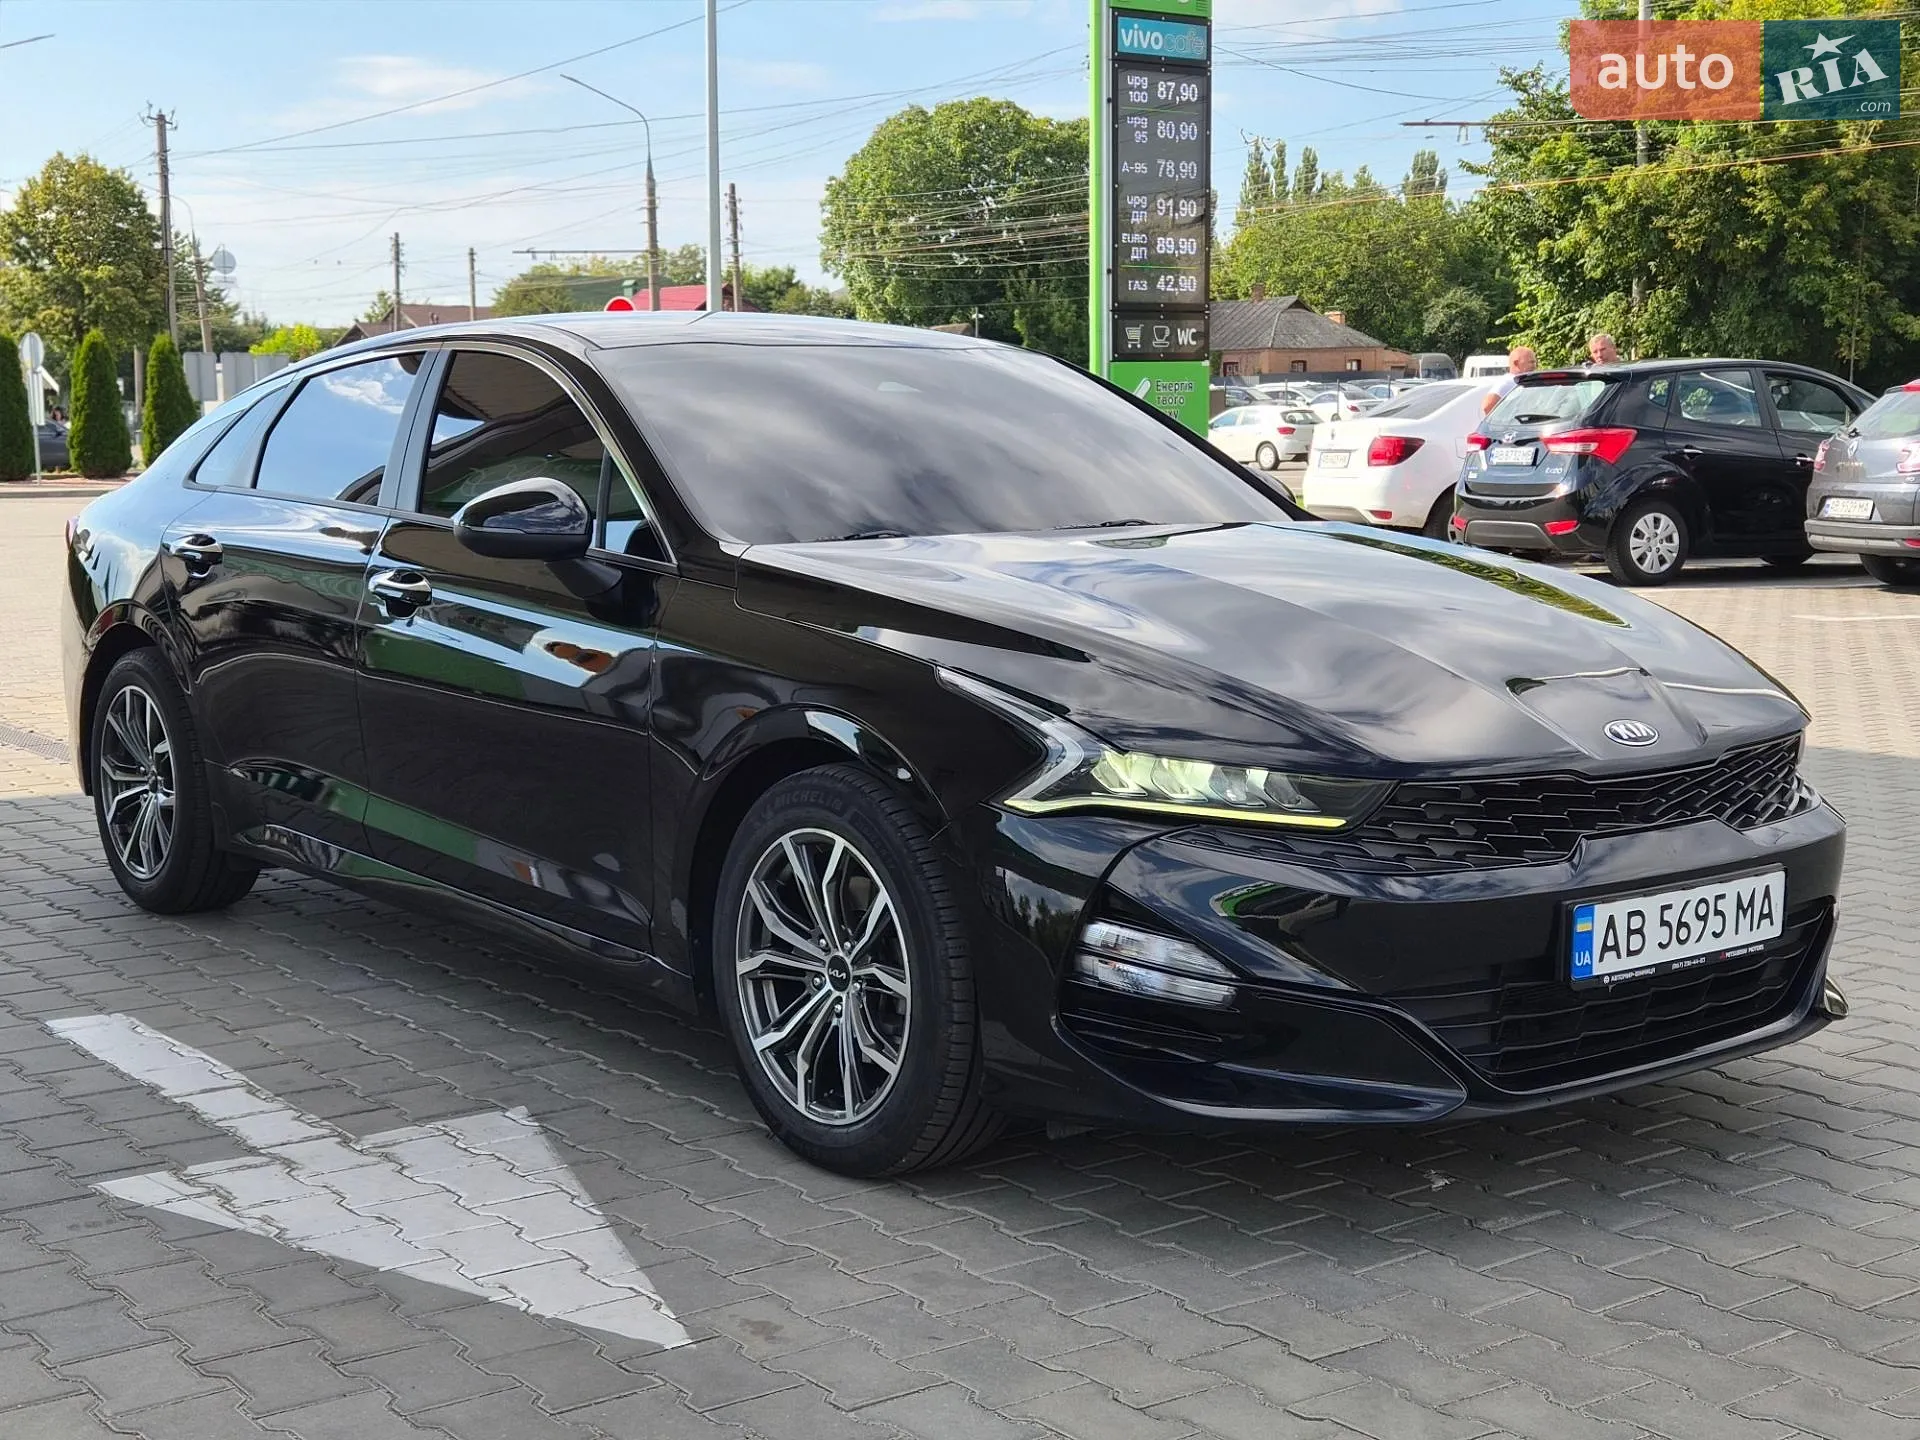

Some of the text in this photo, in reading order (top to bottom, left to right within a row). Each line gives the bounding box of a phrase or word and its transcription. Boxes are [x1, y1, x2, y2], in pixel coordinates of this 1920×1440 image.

[1127, 75, 1148, 89] upg
[1128, 91, 1148, 103] 100
[1157, 81, 1198, 104] 87,90
[1127, 116, 1148, 129] upg
[1134, 131, 1148, 143] 95
[1157, 120, 1198, 143] 80,90
[1157, 159, 1197, 181] 78,90
[1126, 195, 1148, 208] upg
[1156, 198, 1197, 220] 91,90
[1130, 210, 1148, 225] ДП
[1121, 233, 1148, 243] EURO
[1130, 247, 1148, 261] ДП
[1156, 237, 1197, 257] 89,90
[1128, 275, 1197, 296] ГАЗ 42,90
[1177, 328, 1197, 345] WC
[1156, 380, 1193, 392] Енергія
[1157, 396, 1185, 405] твого
[1610, 722, 1655, 740] KIA
[1599, 884, 1774, 963] AB 5695 MA
[1575, 951, 1592, 967] UA
